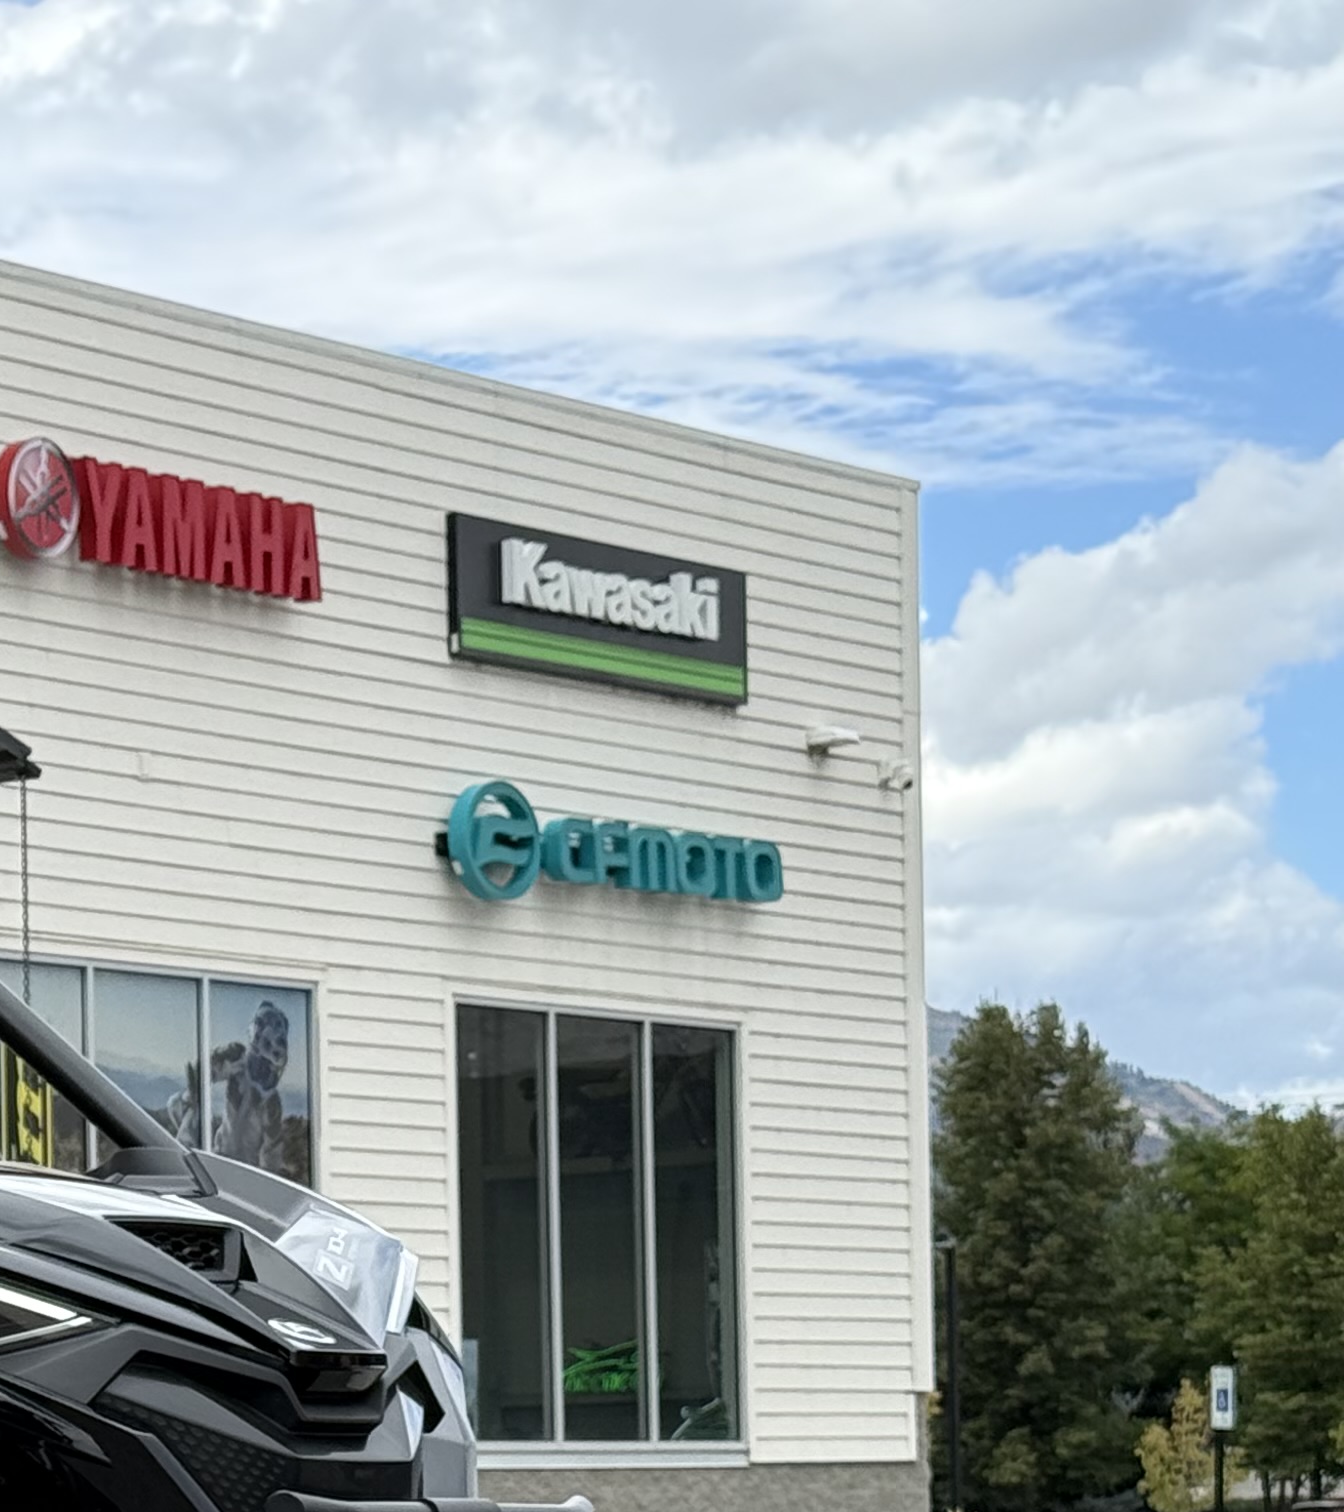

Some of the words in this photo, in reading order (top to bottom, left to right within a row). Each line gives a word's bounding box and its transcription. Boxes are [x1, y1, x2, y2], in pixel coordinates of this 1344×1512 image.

[69, 456, 323, 602] YAMAHA
[500, 537, 720, 641] Kawasaki
[542, 817, 785, 902] CFMOTO
